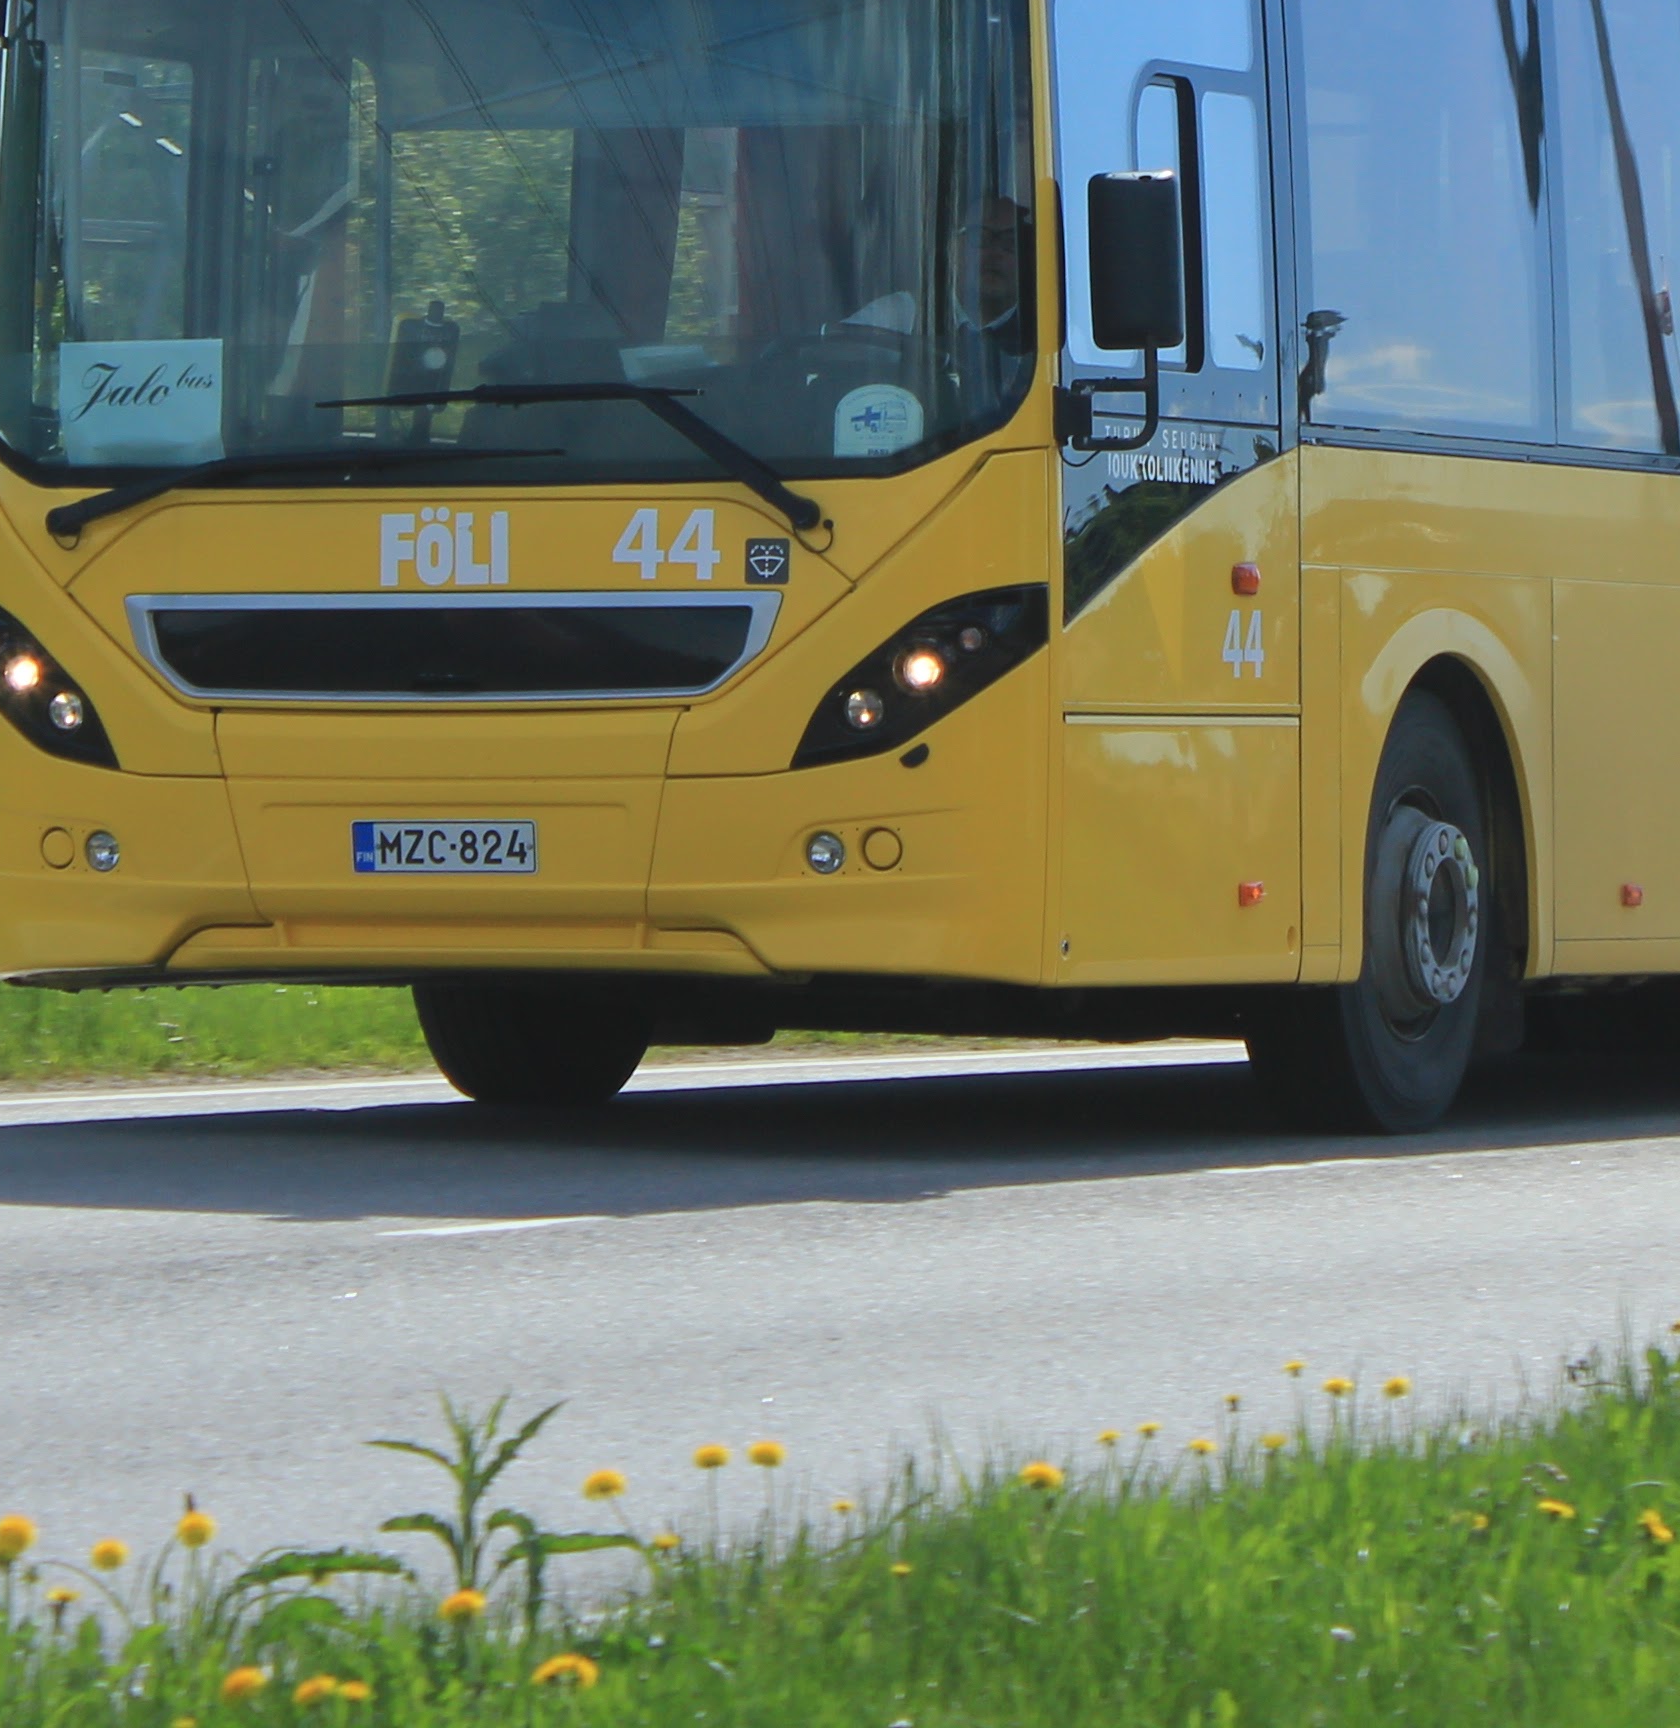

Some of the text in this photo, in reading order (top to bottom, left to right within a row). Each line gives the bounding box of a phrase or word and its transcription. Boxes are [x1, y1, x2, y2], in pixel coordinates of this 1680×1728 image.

[69, 362, 214, 422] Jalo bus
[1162, 429, 1216, 452] SEUDUN
[380, 506, 721, 587] FÖLI 44
[1222, 609, 1264, 678] 44
[356, 828, 528, 865] FIN MZC-824
